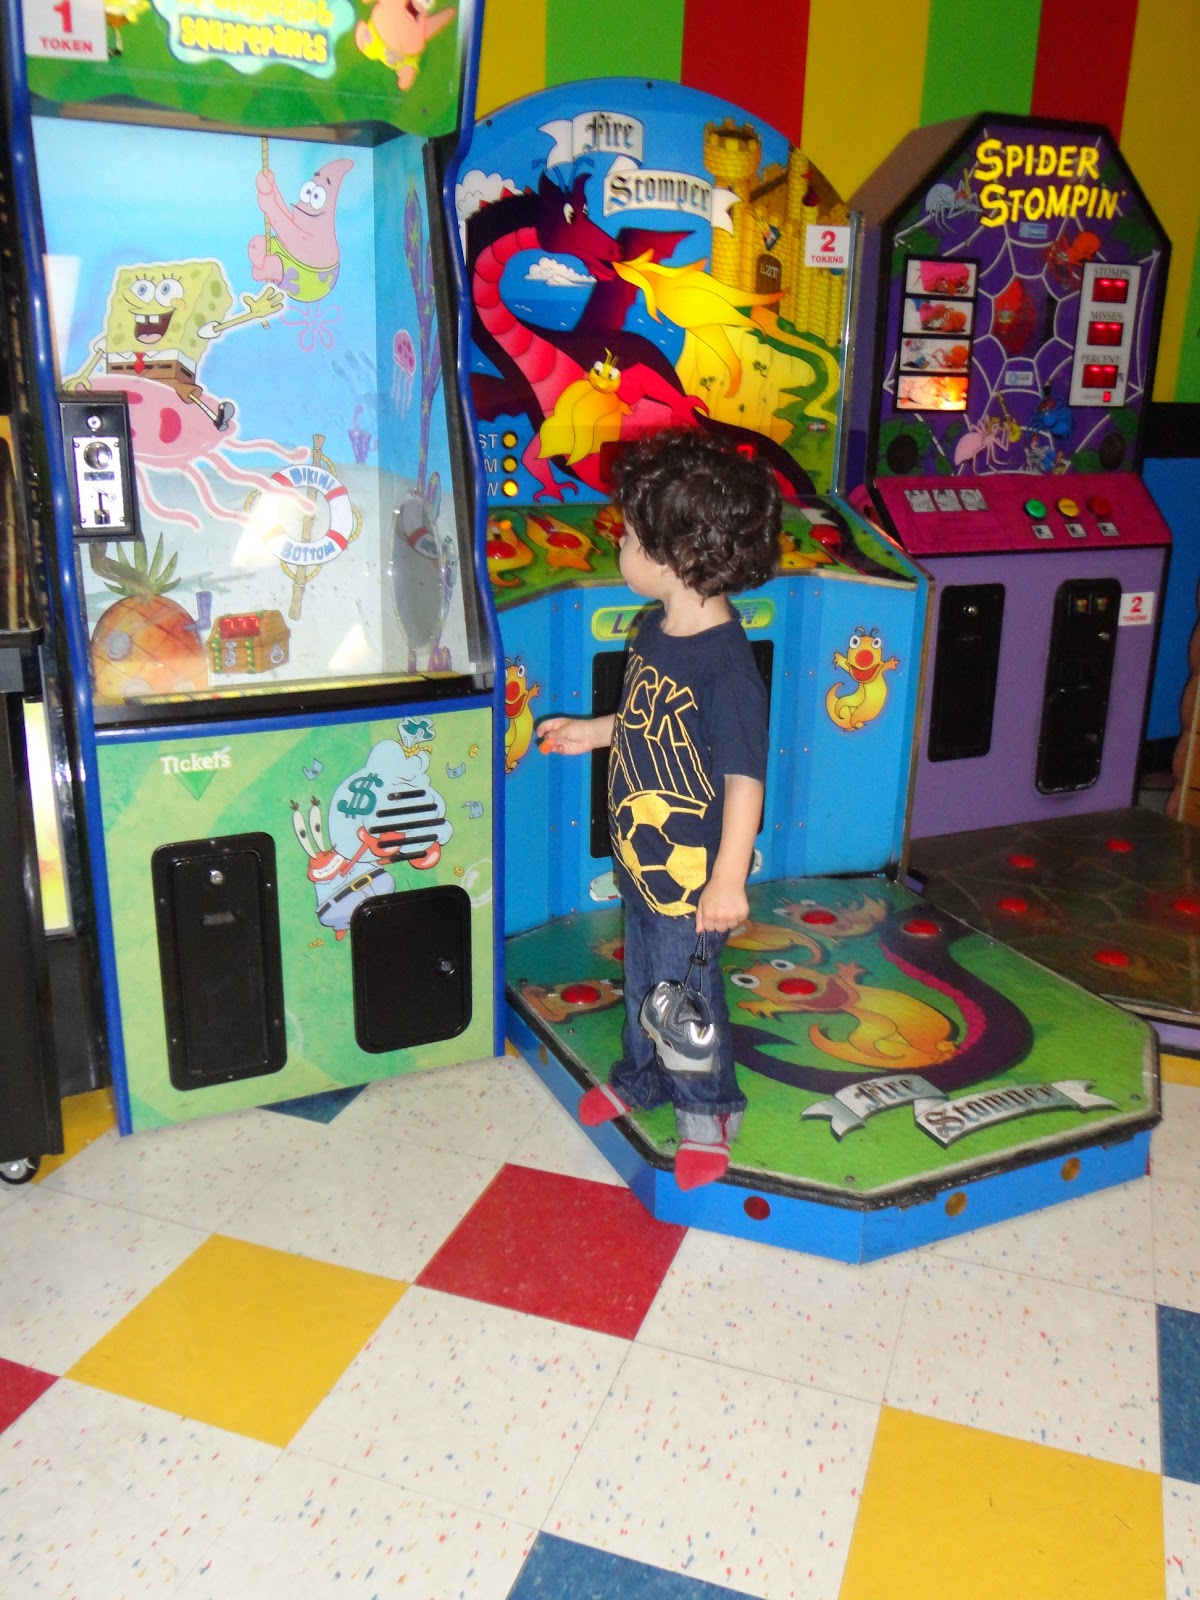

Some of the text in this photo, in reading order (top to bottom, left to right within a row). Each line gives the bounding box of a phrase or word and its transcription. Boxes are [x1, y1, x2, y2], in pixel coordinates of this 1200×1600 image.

[53, 0, 73, 33] 1
[40, 36, 93, 53] TOKEN
[584, 113, 634, 151] Fire
[974, 138, 1100, 181] SPIDER
[606, 175, 710, 211] Stomper
[820, 230, 836, 253] 2
[810, 255, 844, 264] TOKENS
[1090, 311, 1122, 321] MISSES
[1081, 355, 1120, 364] PERCENT
[478, 433, 499, 449] ST
[289, 467, 336, 491] BIKINI
[281, 540, 336, 562] BOTTOM
[1130, 595, 1143, 613] 2
[160, 748, 231, 774] Tickets
[924, 1086, 1055, 1138] Stomper
